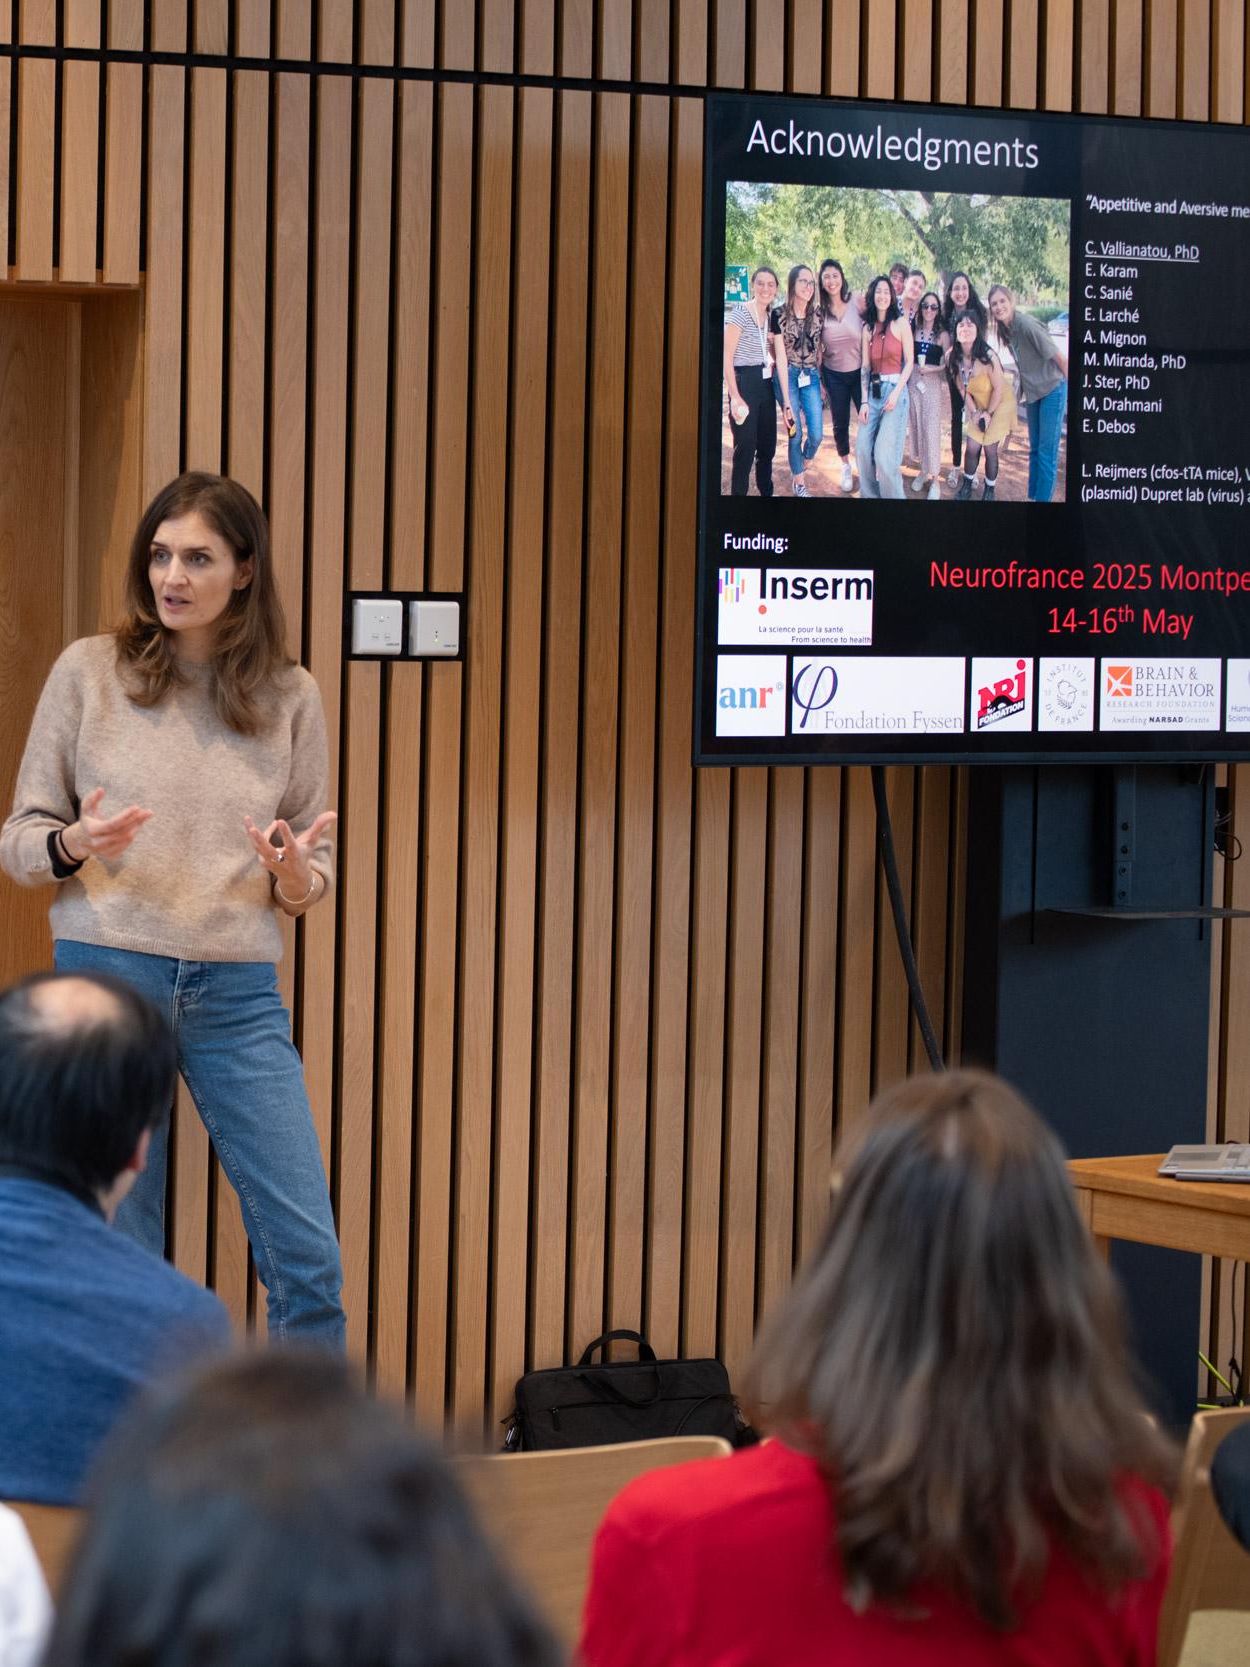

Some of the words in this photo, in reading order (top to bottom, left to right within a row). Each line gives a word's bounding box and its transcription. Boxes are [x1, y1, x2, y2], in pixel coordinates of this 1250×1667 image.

[746, 119, 1039, 171] Acknowledgments
[1154, 199, 1176, 214] and
[1179, 201, 1228, 217] Aversive
[1085, 241, 1097, 255] C.
[1100, 241, 1172, 260] Vallianatou,
[1174, 245, 1200, 260] PhD
[1085, 262, 1096, 277] E.
[1100, 263, 1138, 278] Karam
[1084, 285, 1096, 299] C.
[1099, 285, 1133, 300] Sanié
[1084, 307, 1095, 321] E.
[1099, 308, 1140, 323] Larché
[1083, 329, 1096, 344] A.
[1100, 330, 1147, 348] Mignon
[1084, 352, 1100, 366] M.
[1104, 353, 1158, 370] Miranda,
[1161, 354, 1186, 369] PhD
[1082, 374, 1091, 388] J.
[1094, 374, 1121, 391] Ster,
[1125, 376, 1150, 390] PhD
[1083, 396, 1099, 413] M,
[1103, 397, 1162, 412] Drahmani
[1082, 419, 1093, 433] E.
[1097, 419, 1136, 434] Debos
[1081, 463, 1092, 478] L.
[1095, 464, 1147, 481] Reijmers
[1150, 464, 1203, 482] (cfos-tTA
[1206, 466, 1242, 484] mice),
[1081, 485, 1138, 503] (plasmid)
[1141, 487, 1183, 504] Dupret
[1186, 487, 1204, 501] lab
[1207, 488, 1244, 506] (virus)
[723, 532, 789, 554] Funding:
[760, 568, 872, 600] Inserm
[929, 560, 1084, 589] Neurofrance
[1092, 563, 1152, 590] 2025
[1160, 564, 1250, 597] Montpe
[1142, 608, 1194, 641] May
[849, 636, 872, 644] health
[1135, 666, 1184, 680] BRAIN
[1188, 666, 1199, 680] &
[1134, 683, 1215, 697] BEHAVIOR
[1106, 700, 1152, 708] RESEARCH
[825, 711, 908, 730] Fondation
[912, 711, 963, 733] Fyssen
[978, 700, 1024, 727] FONDATION
